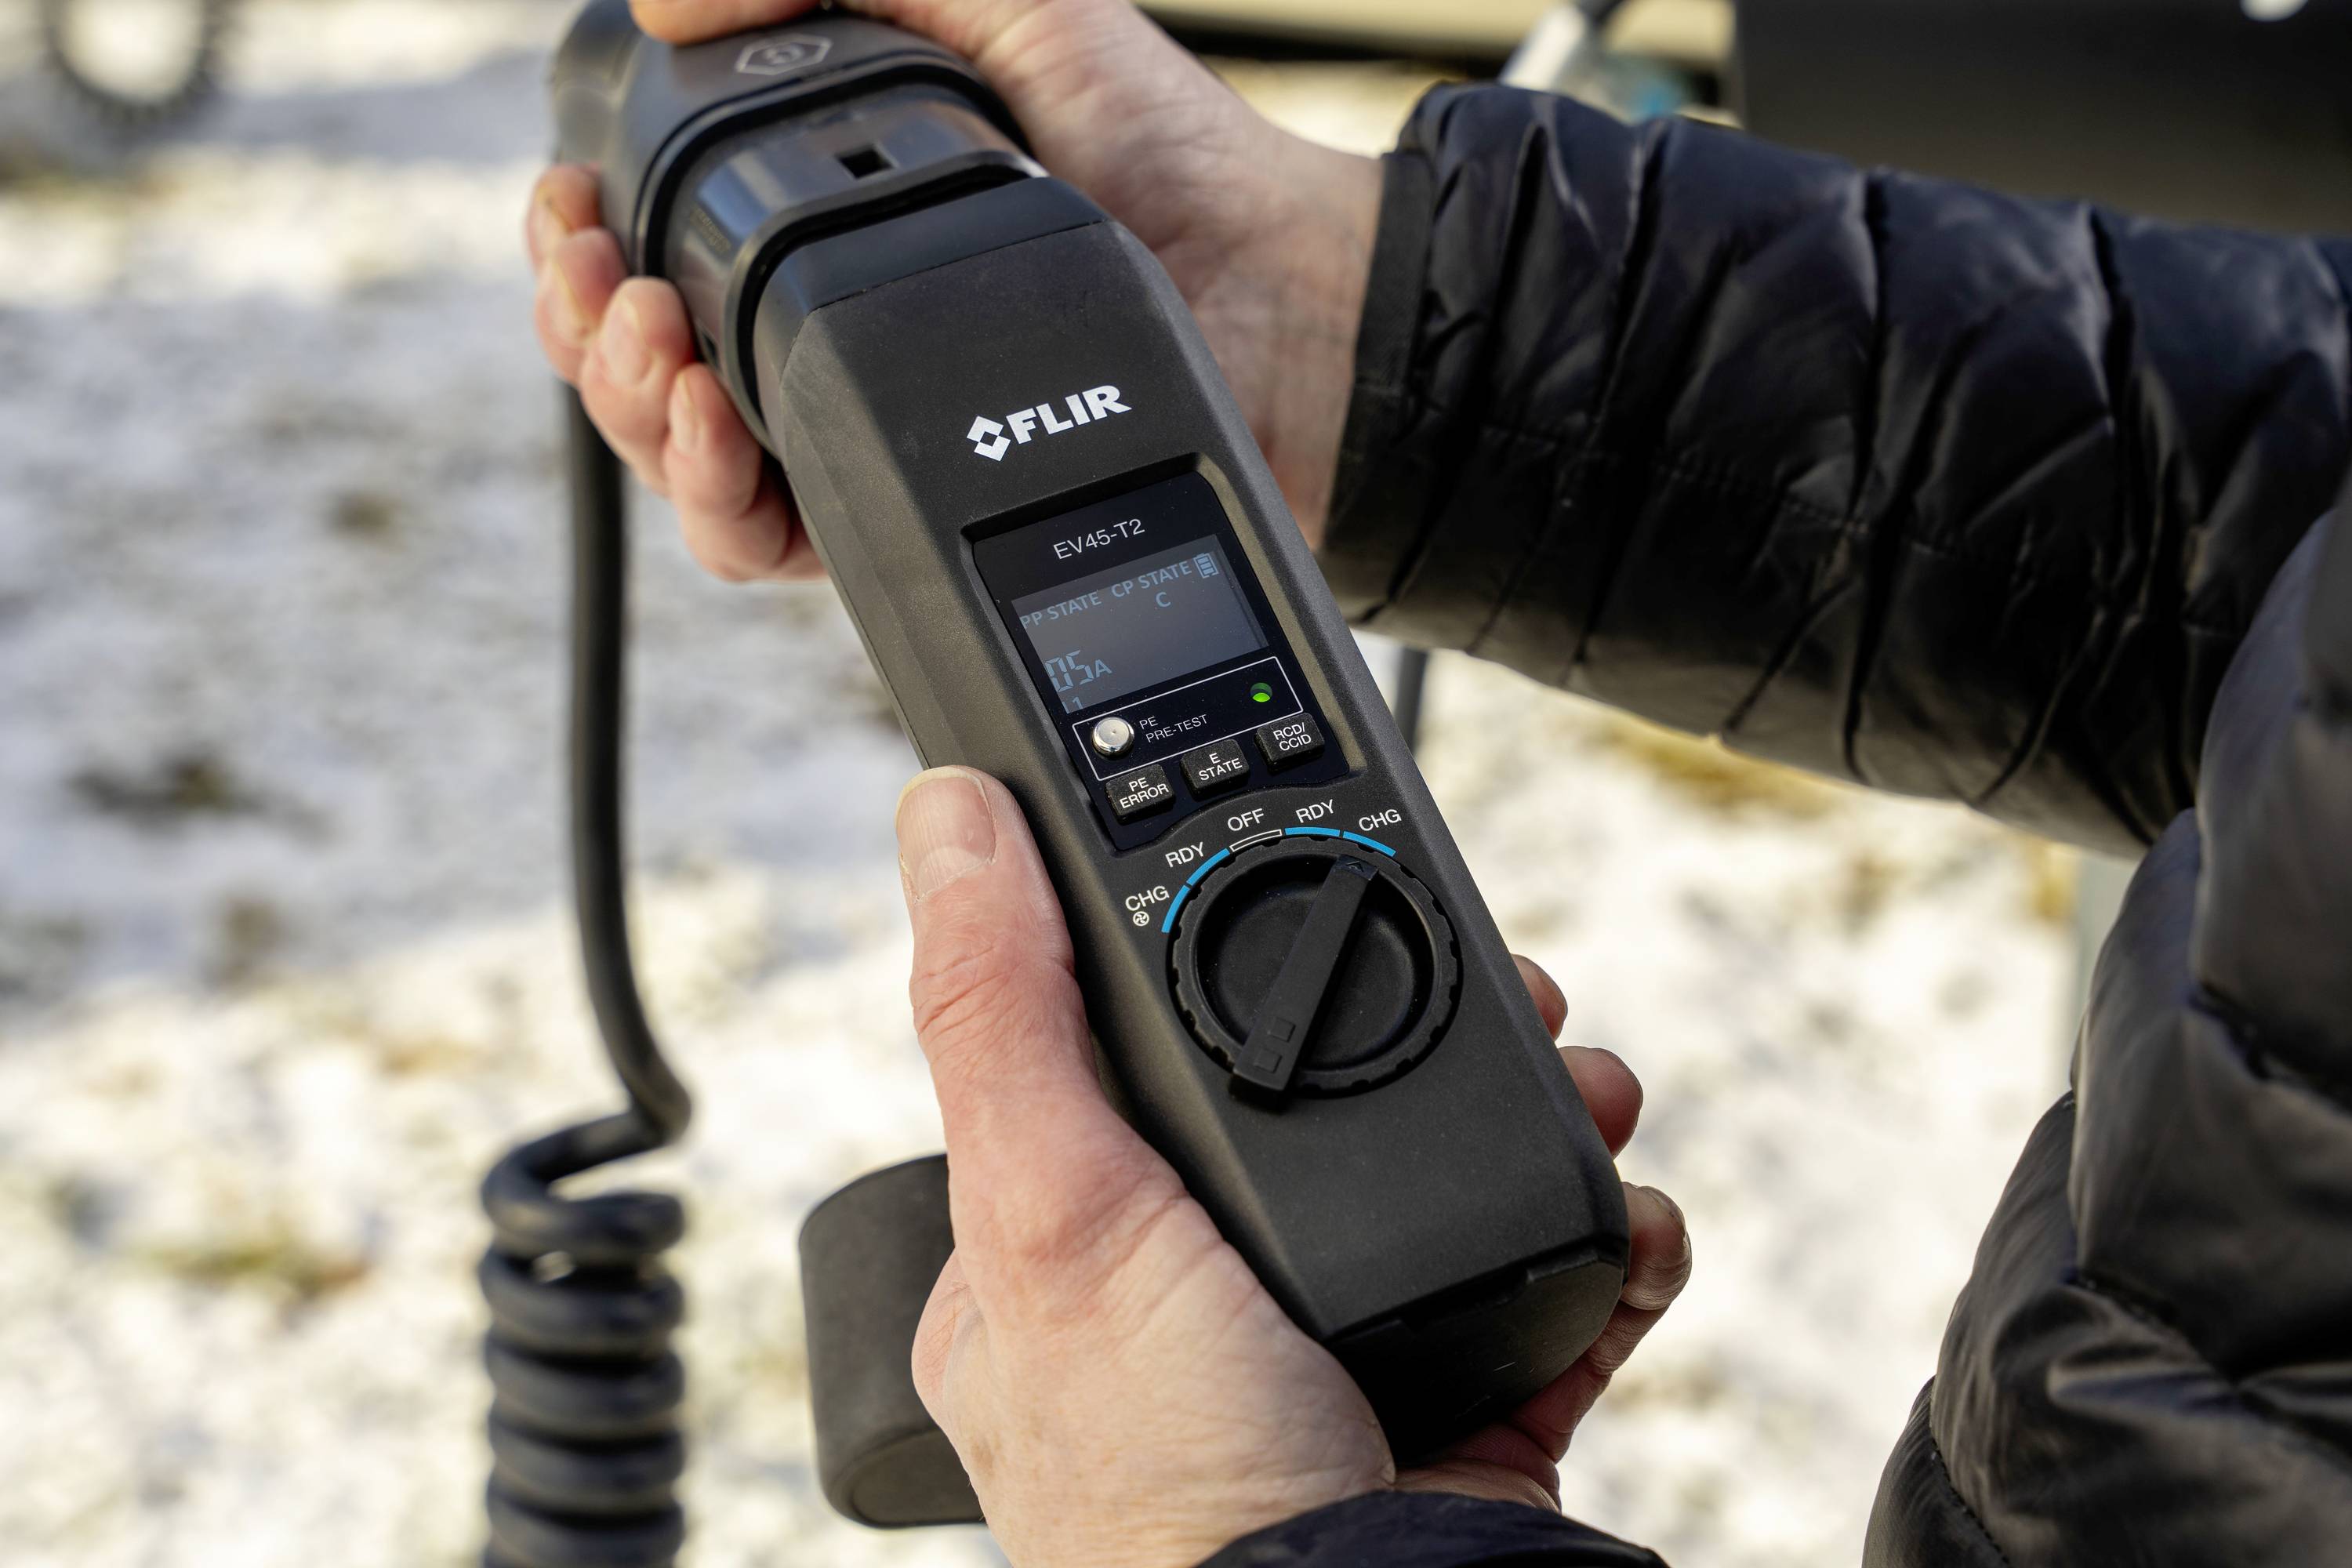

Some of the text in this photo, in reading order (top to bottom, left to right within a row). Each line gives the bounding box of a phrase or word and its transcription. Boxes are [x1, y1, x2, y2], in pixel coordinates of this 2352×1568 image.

[1006, 385, 1132, 444] FLIR
[1053, 518, 1145, 560] EV45-T2
[1110, 561, 1192, 598] CP STATE
[1019, 590, 1102, 629] PP STATE
[1156, 591, 1171, 608] C
[1138, 716, 1158, 730] PE
[1145, 714, 1208, 743] PRE-TEST
[1272, 722, 1306, 741] RCD/
[1278, 733, 1312, 752] CCID
[1198, 758, 1243, 781] STATE
[1208, 752, 1220, 765] E
[1128, 776, 1149, 791] PE
[1120, 783, 1170, 809] ERROR
[1227, 808, 1265, 833] OFF
[1296, 799, 1334, 823] RDY
[1359, 808, 1402, 832] CHG
[1165, 841, 1205, 868] RDY
[1125, 885, 1170, 913] CHG
